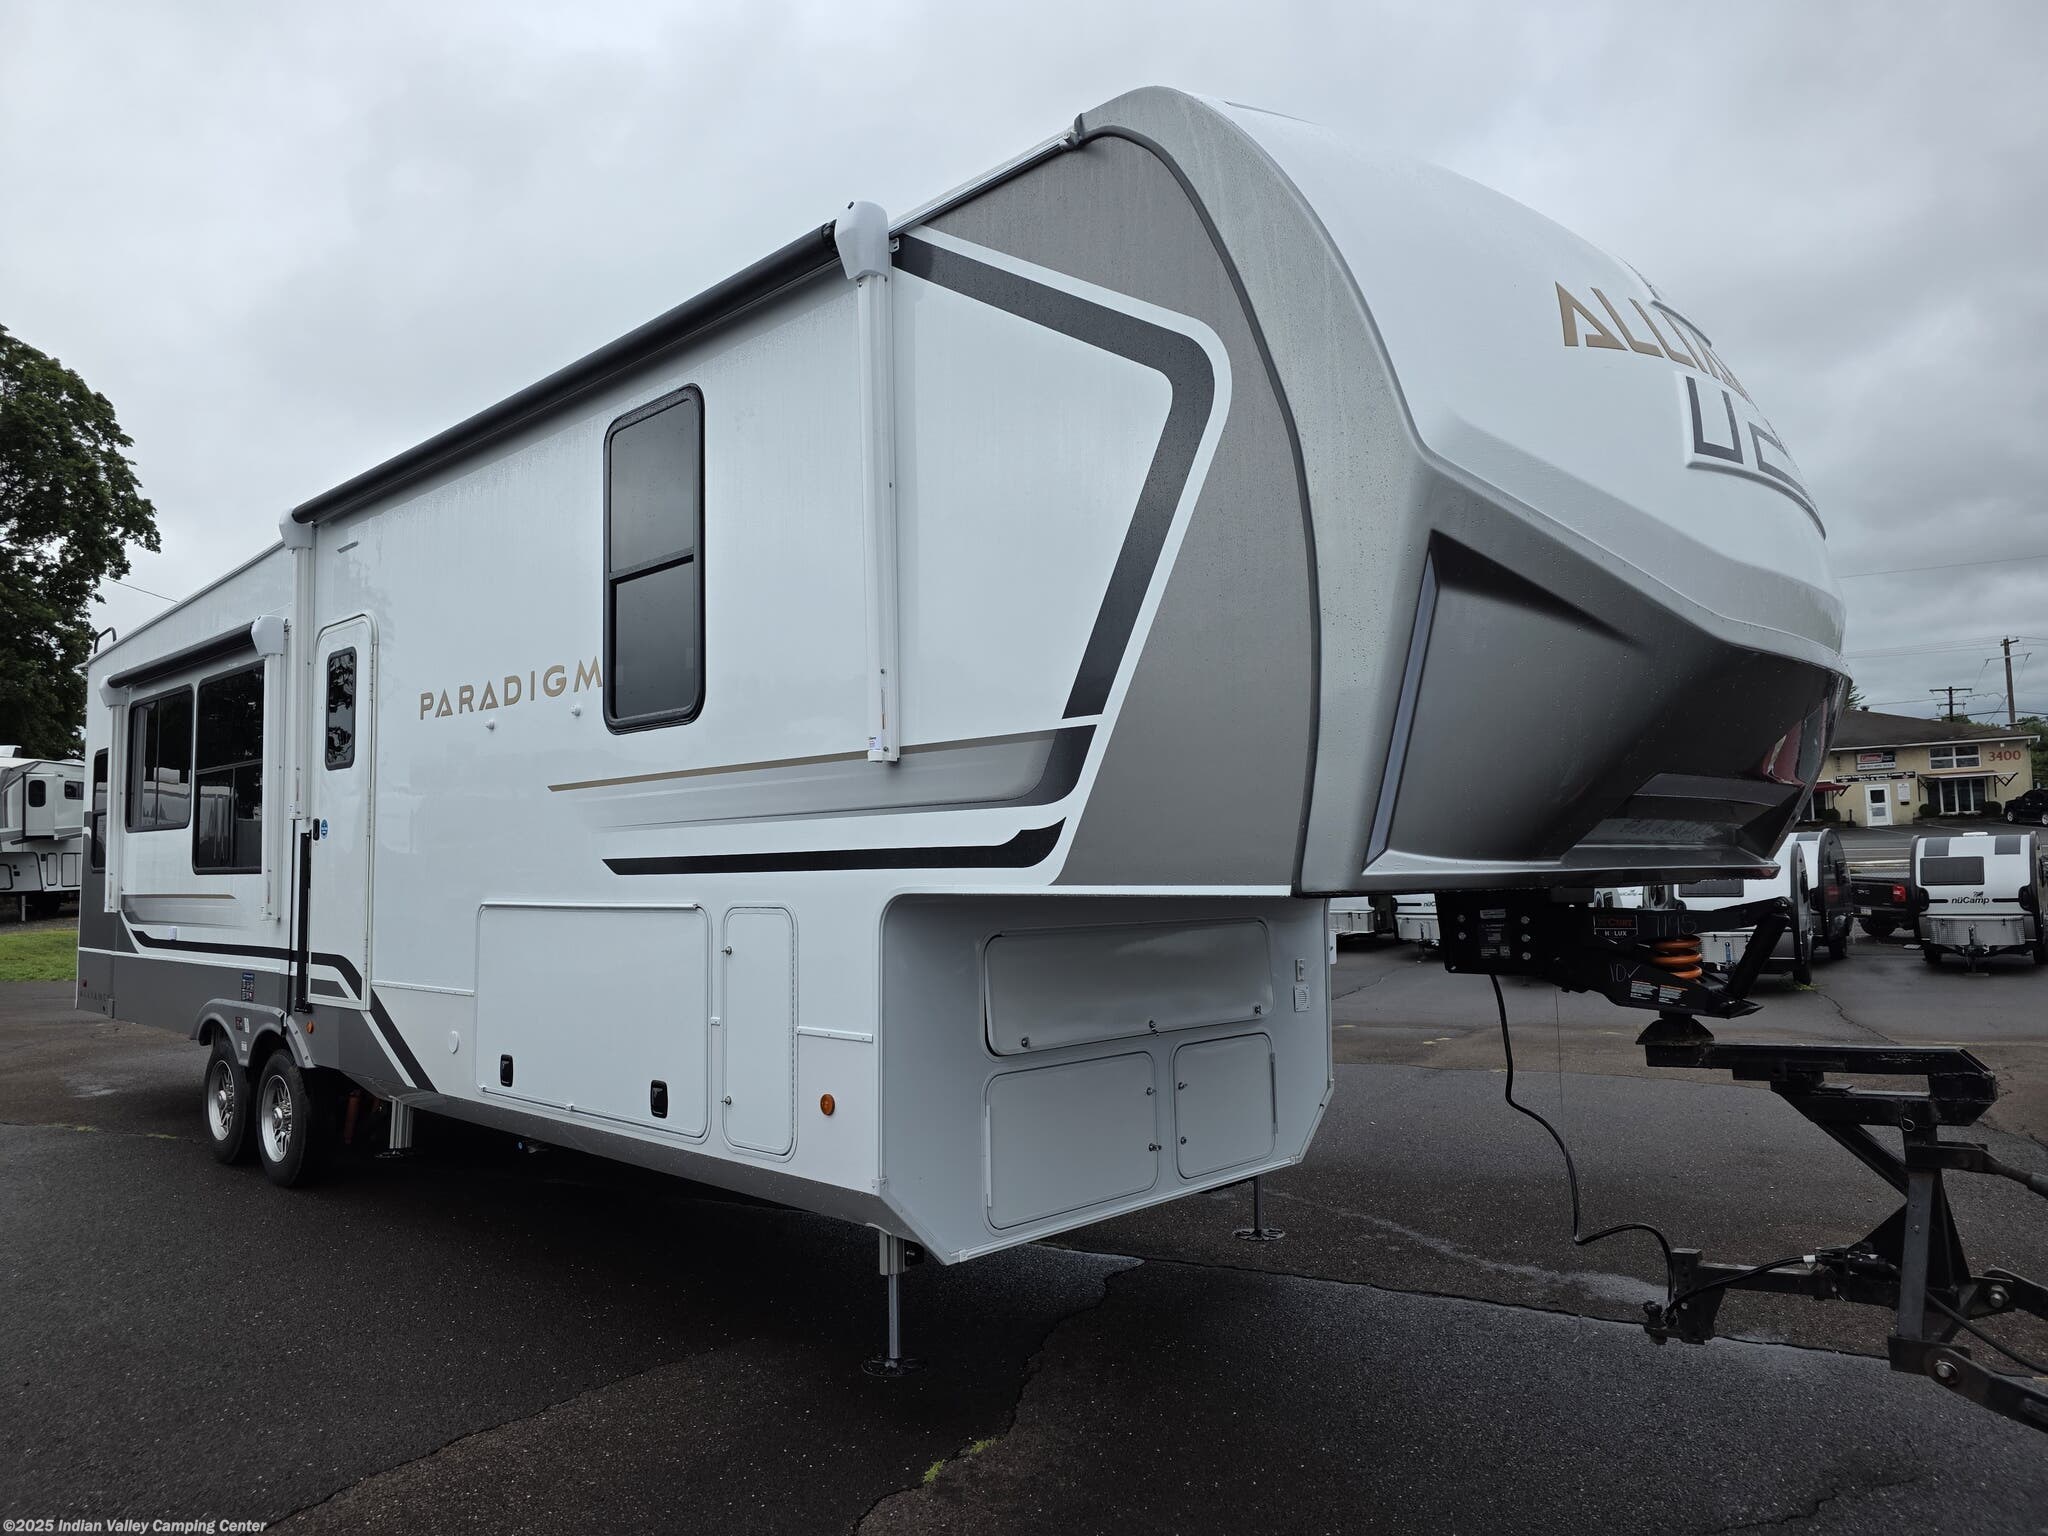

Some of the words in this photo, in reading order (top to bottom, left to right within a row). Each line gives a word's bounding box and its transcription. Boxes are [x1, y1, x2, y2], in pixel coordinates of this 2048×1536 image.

[420, 655, 603, 720] PARADIGM
[1988, 750, 2021, 762] 3400
[1951, 896, 1990, 905] nüCamp
